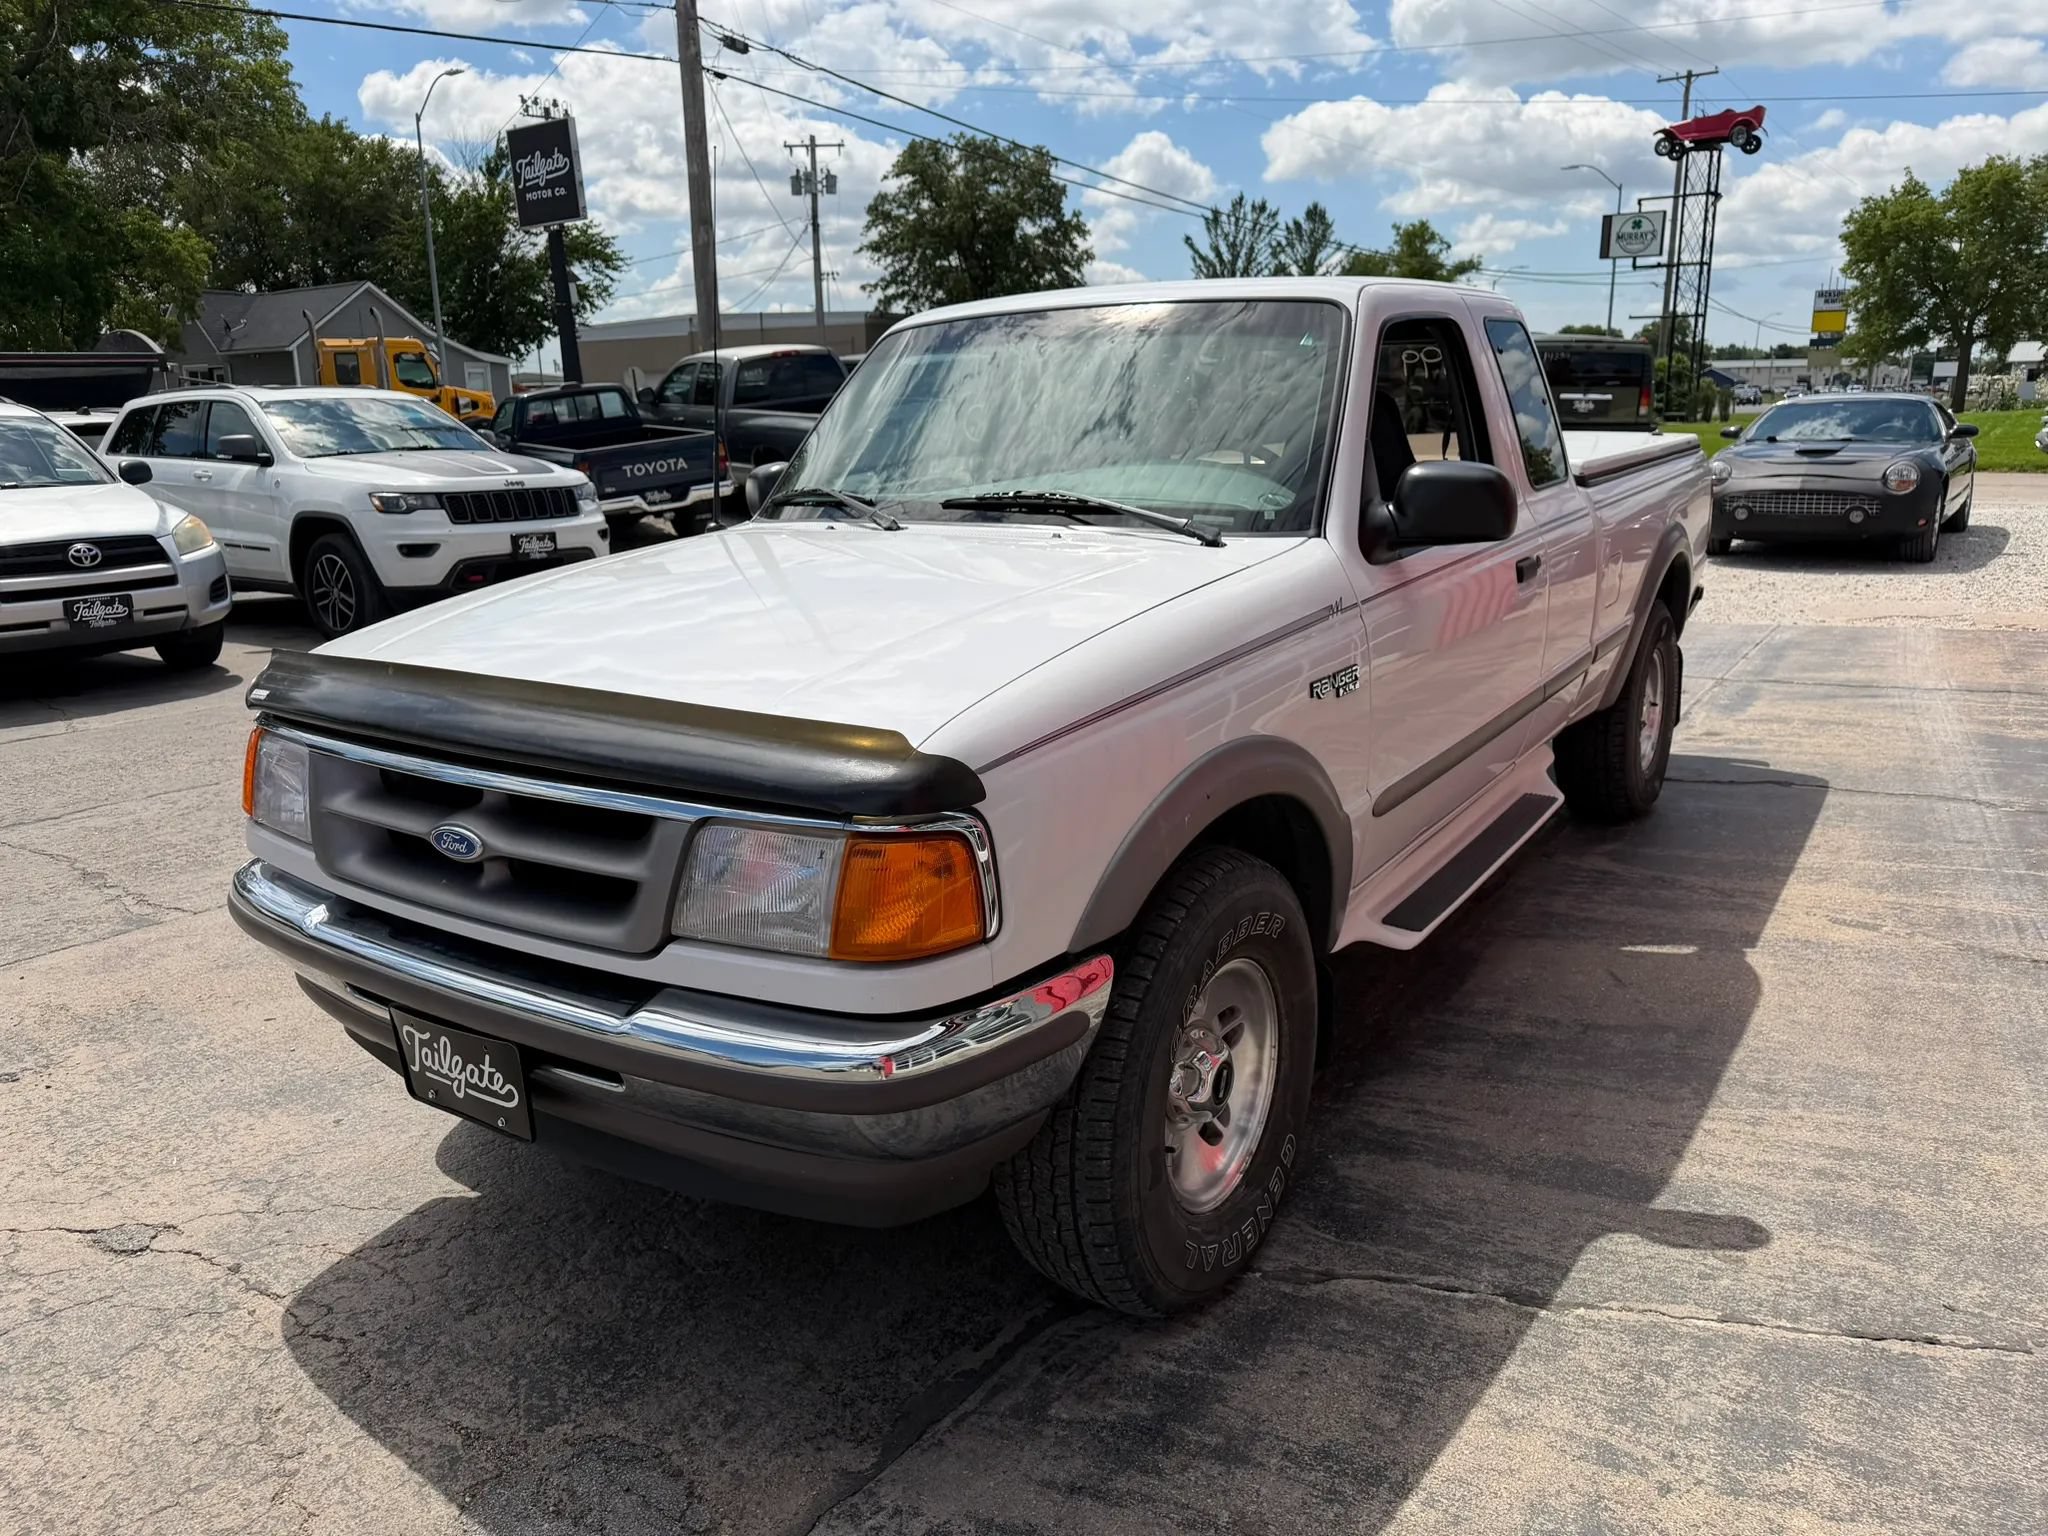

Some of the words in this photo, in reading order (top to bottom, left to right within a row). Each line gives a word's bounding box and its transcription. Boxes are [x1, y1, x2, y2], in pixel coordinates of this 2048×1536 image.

[516, 147, 570, 189] Tailgate
[525, 189, 553, 201] MOTOR
[621, 457, 688, 478] TOYOTA
[503, 479, 526, 488] Jeep
[73, 597, 129, 622] Tailgate
[1309, 664, 1361, 699] RANGER
[1336, 681, 1360, 698] XLT
[440, 832, 468, 854] Ford
[403, 1025, 519, 1108] Tailgate
[1185, 1132, 1298, 1273] GENERAL
